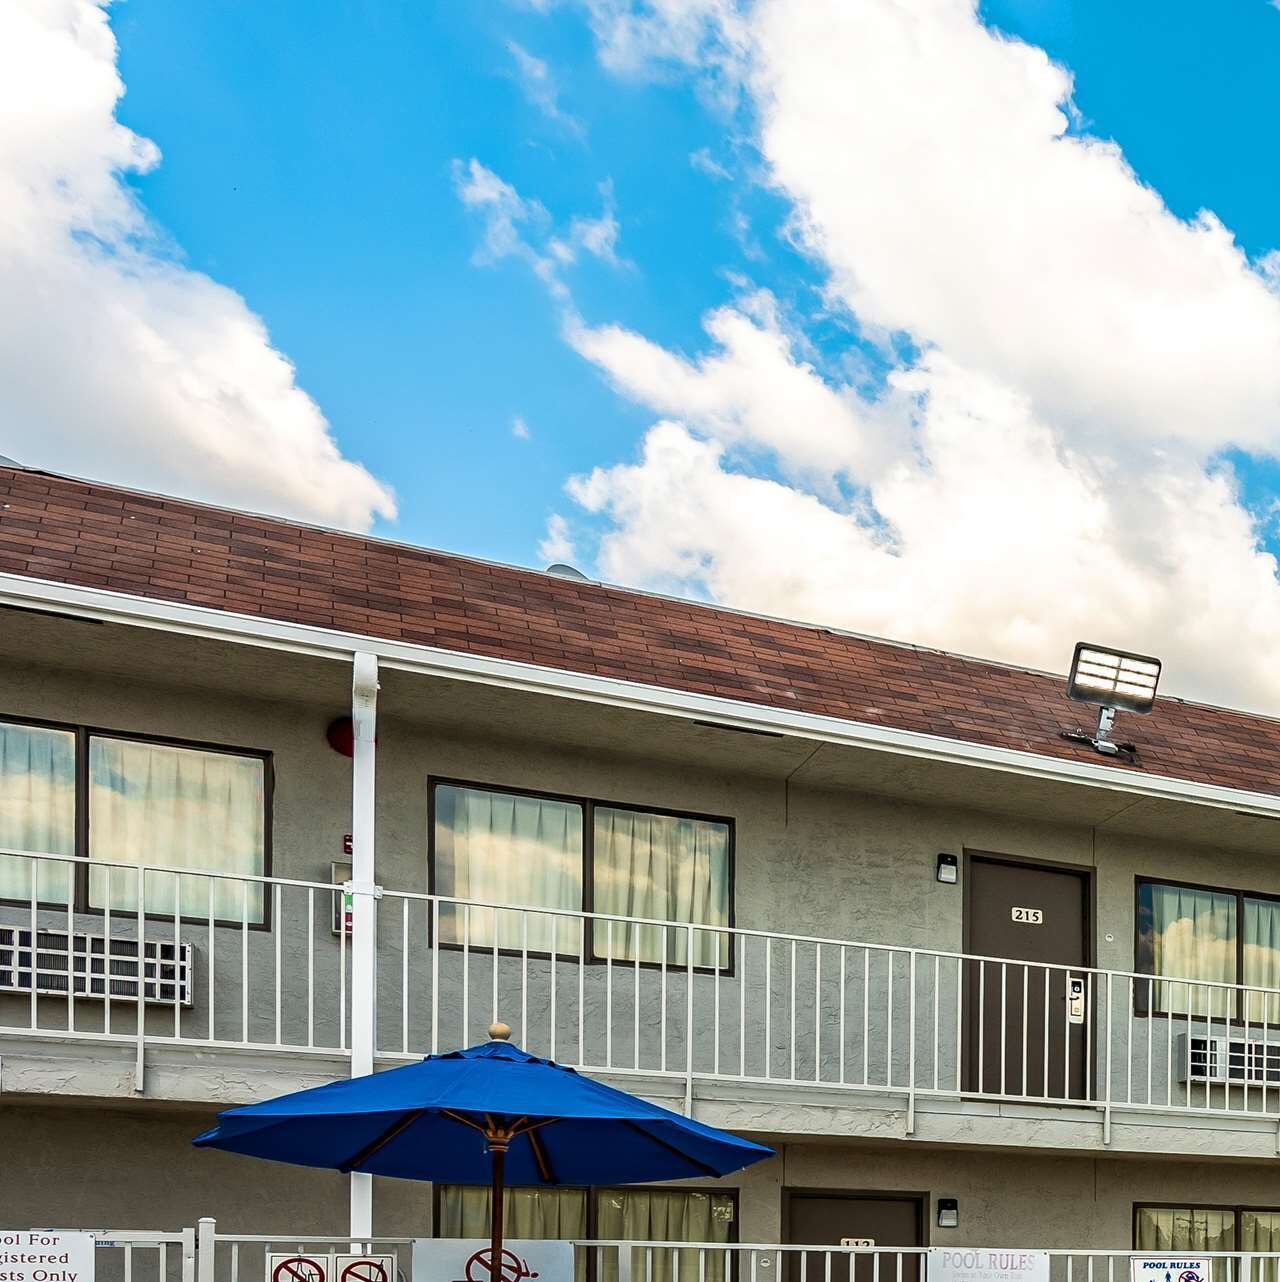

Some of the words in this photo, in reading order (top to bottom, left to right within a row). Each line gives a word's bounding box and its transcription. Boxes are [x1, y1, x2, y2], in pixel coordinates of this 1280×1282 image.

[1015, 909, 1040, 922] 215
[0, 1233, 20, 1245] ol
[29, 1233, 60, 1245] For
[0, 1251, 69, 1265] istered
[943, 1251, 984, 1269] POOL
[989, 1253, 1035, 1271] RULES
[1143, 1261, 1168, 1270] POOL
[1169, 1261, 1201, 1270] RULES
